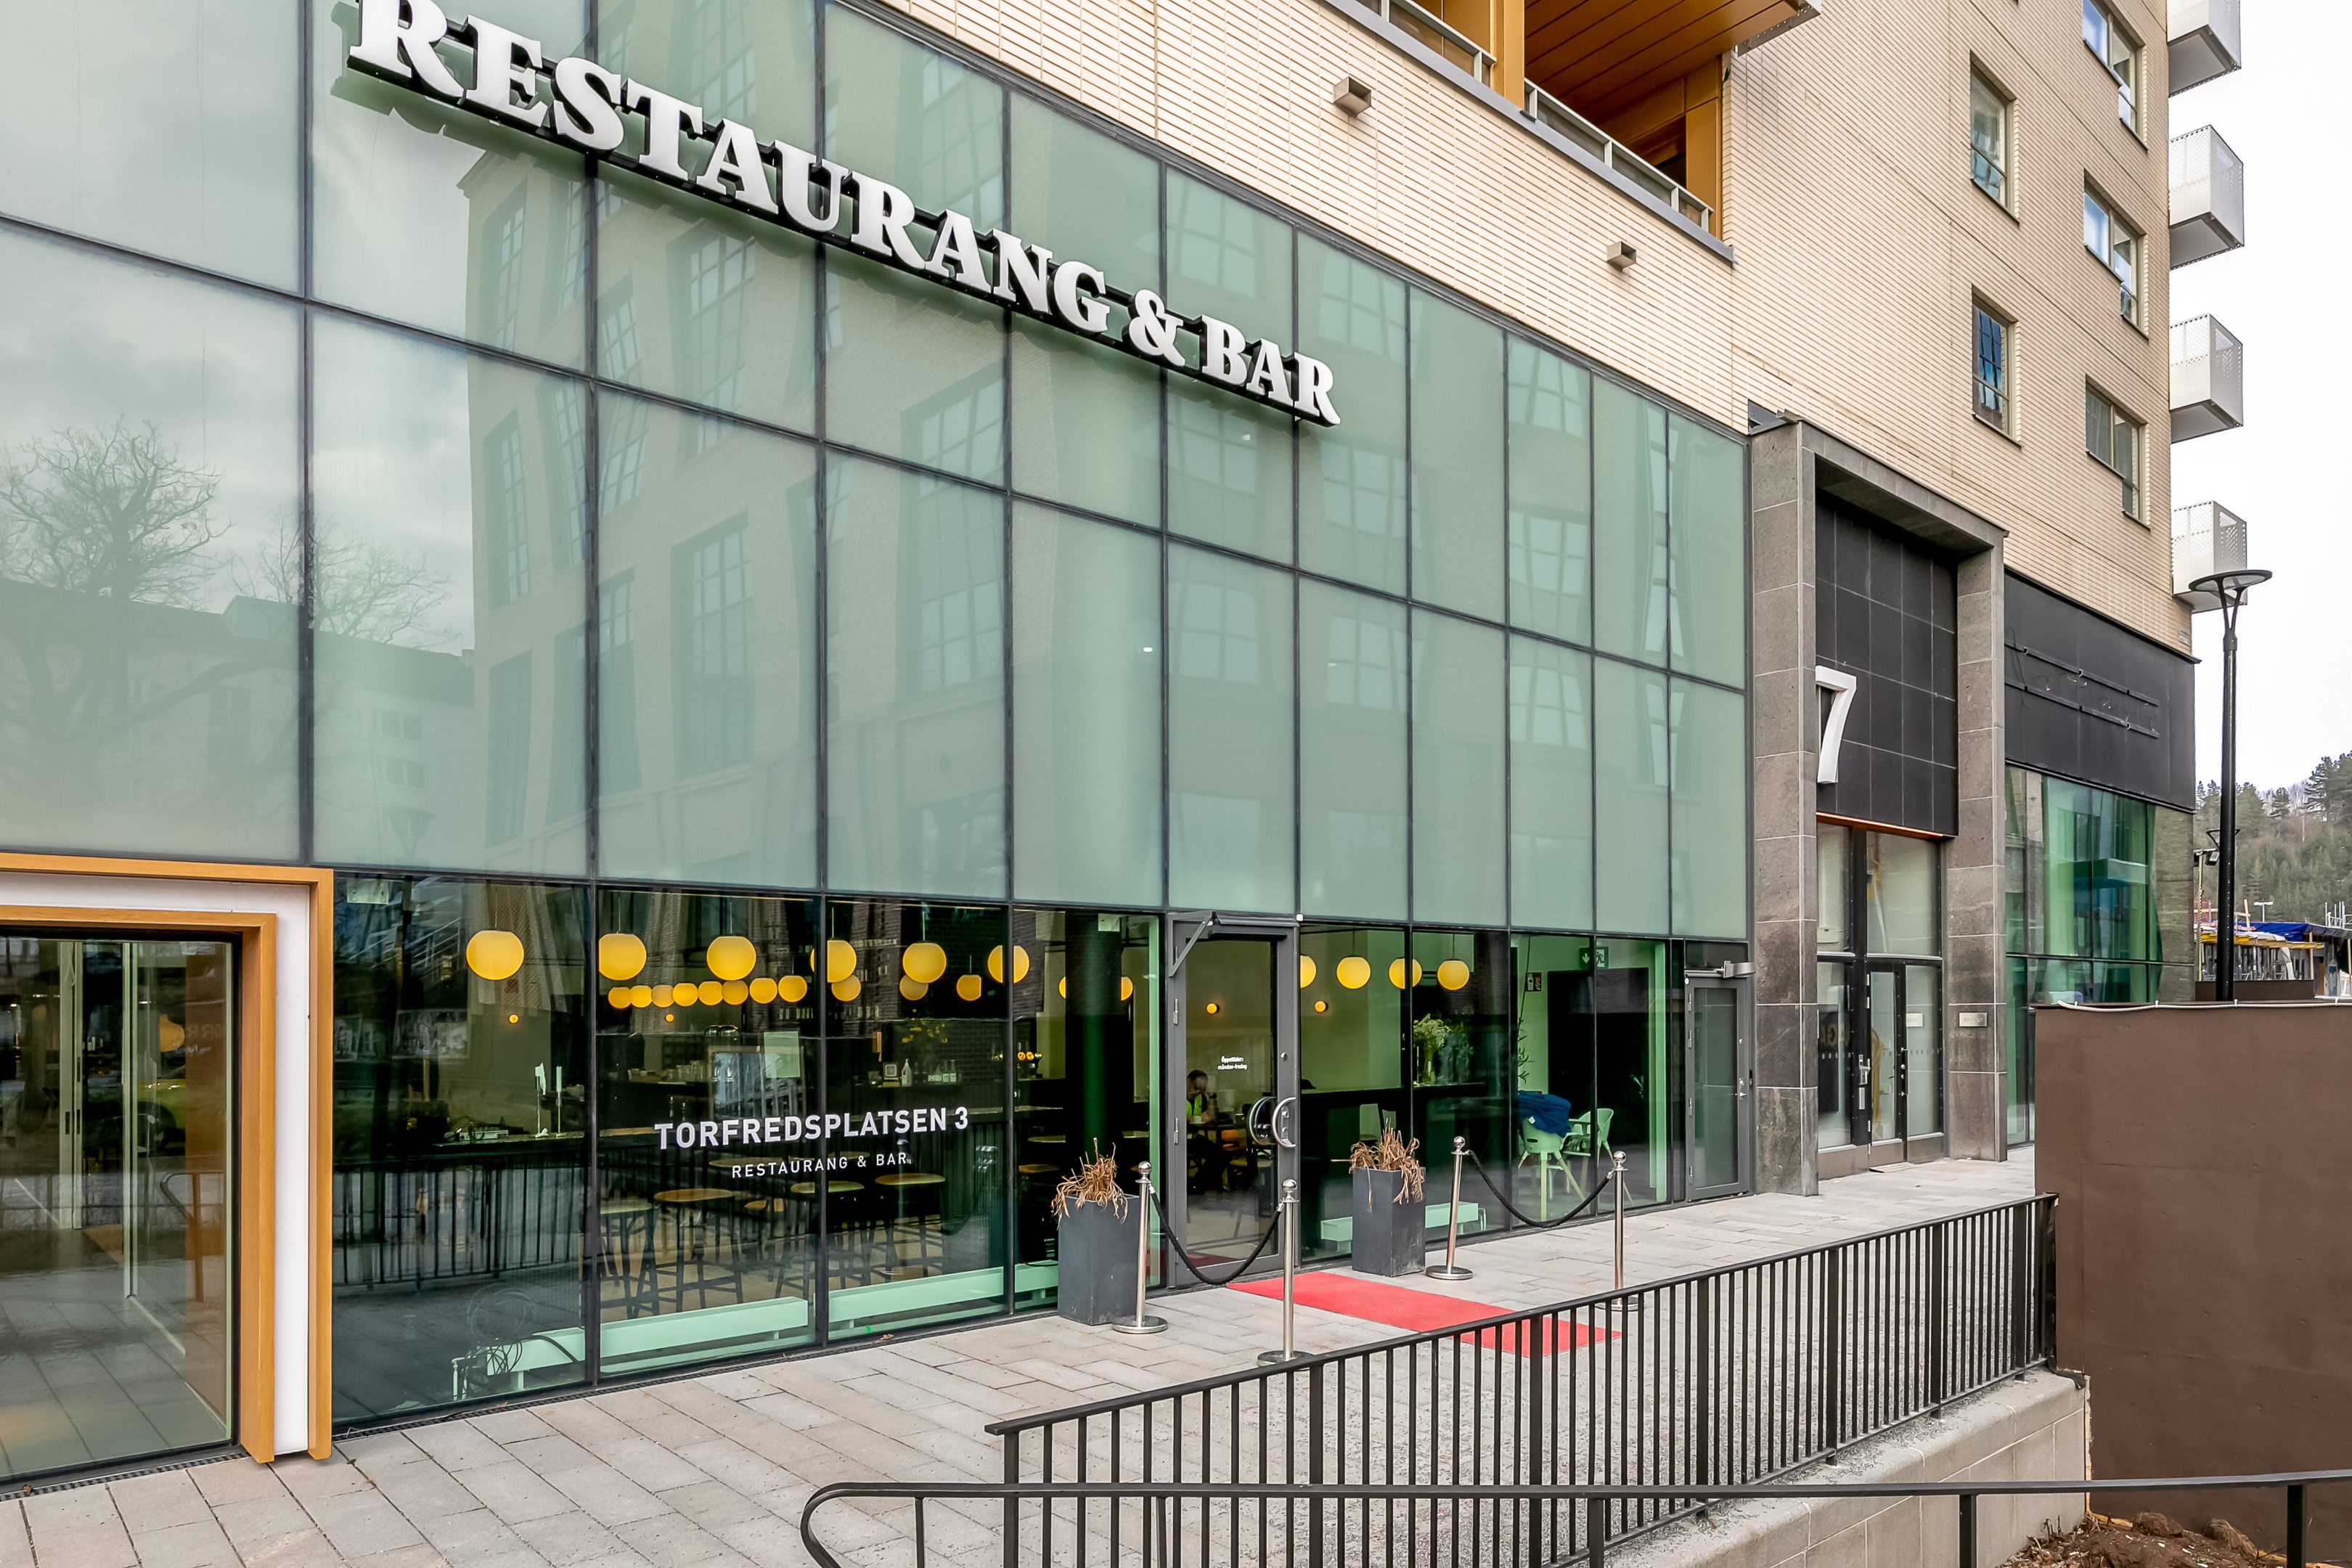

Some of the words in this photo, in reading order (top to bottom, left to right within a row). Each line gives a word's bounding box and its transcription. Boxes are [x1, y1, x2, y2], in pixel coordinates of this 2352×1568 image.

[349, 0, 1111, 332] RESTAURANG
[1127, 289, 1185, 367] &
[1201, 314, 1341, 425] BAR
[1815, 666, 1857, 784] 7
[654, 1107, 947, 1150] TORFREDSPLATSEN
[955, 1106, 968, 1130] 3
[732, 1156, 848, 1178] RESTAURANG
[857, 1155, 867, 1167] &
[876, 1152, 907, 1166] BAR
